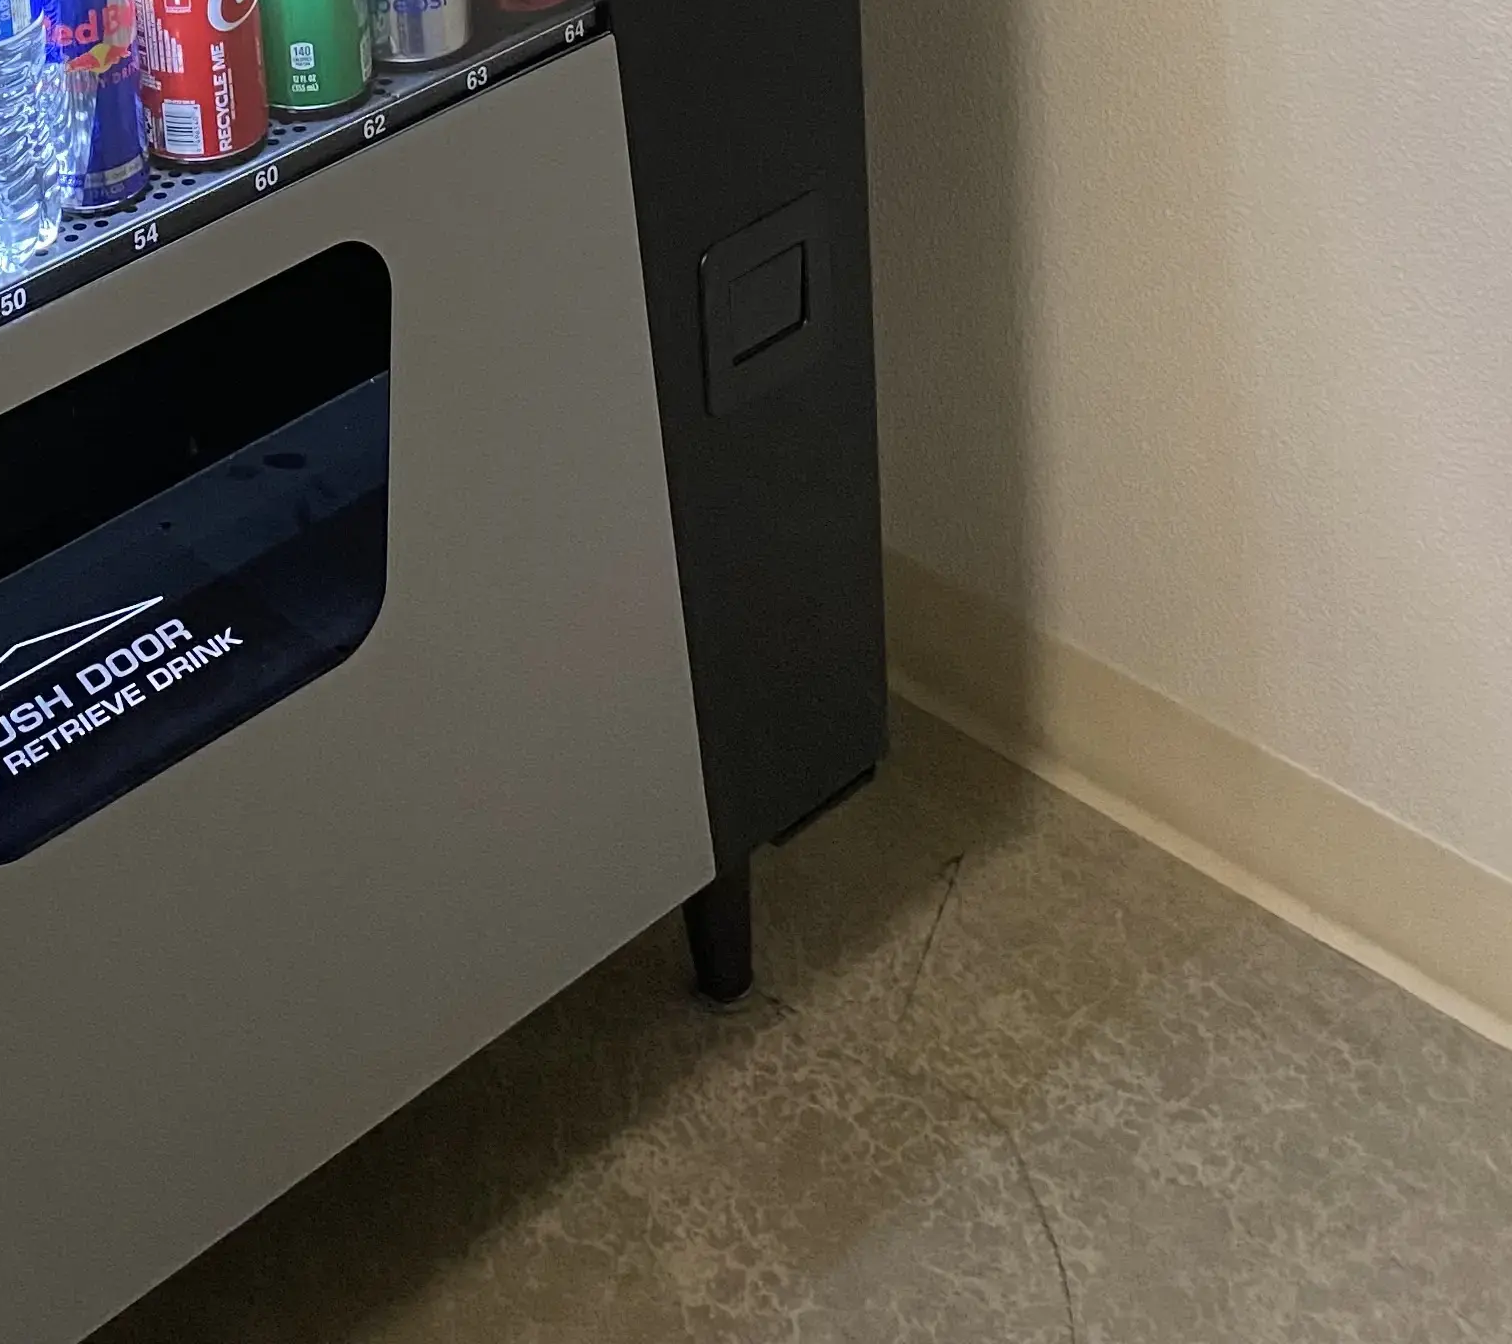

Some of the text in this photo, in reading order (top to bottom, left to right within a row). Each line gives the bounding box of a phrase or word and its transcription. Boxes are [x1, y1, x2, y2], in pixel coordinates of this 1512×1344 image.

[564, 18, 585, 45] 64
[293, 45, 311, 56] 140
[466, 66, 488, 90] 63
[211, 41, 233, 153] RECYCLE ME
[363, 114, 386, 140] 62
[254, 164, 279, 192] 60
[133, 224, 161, 252] 54
[0, 287, 27, 317] 50
[75, 617, 194, 697] DOOR
[2, 683, 147, 777] RETRIEVE
[146, 626, 244, 693] DRINK
